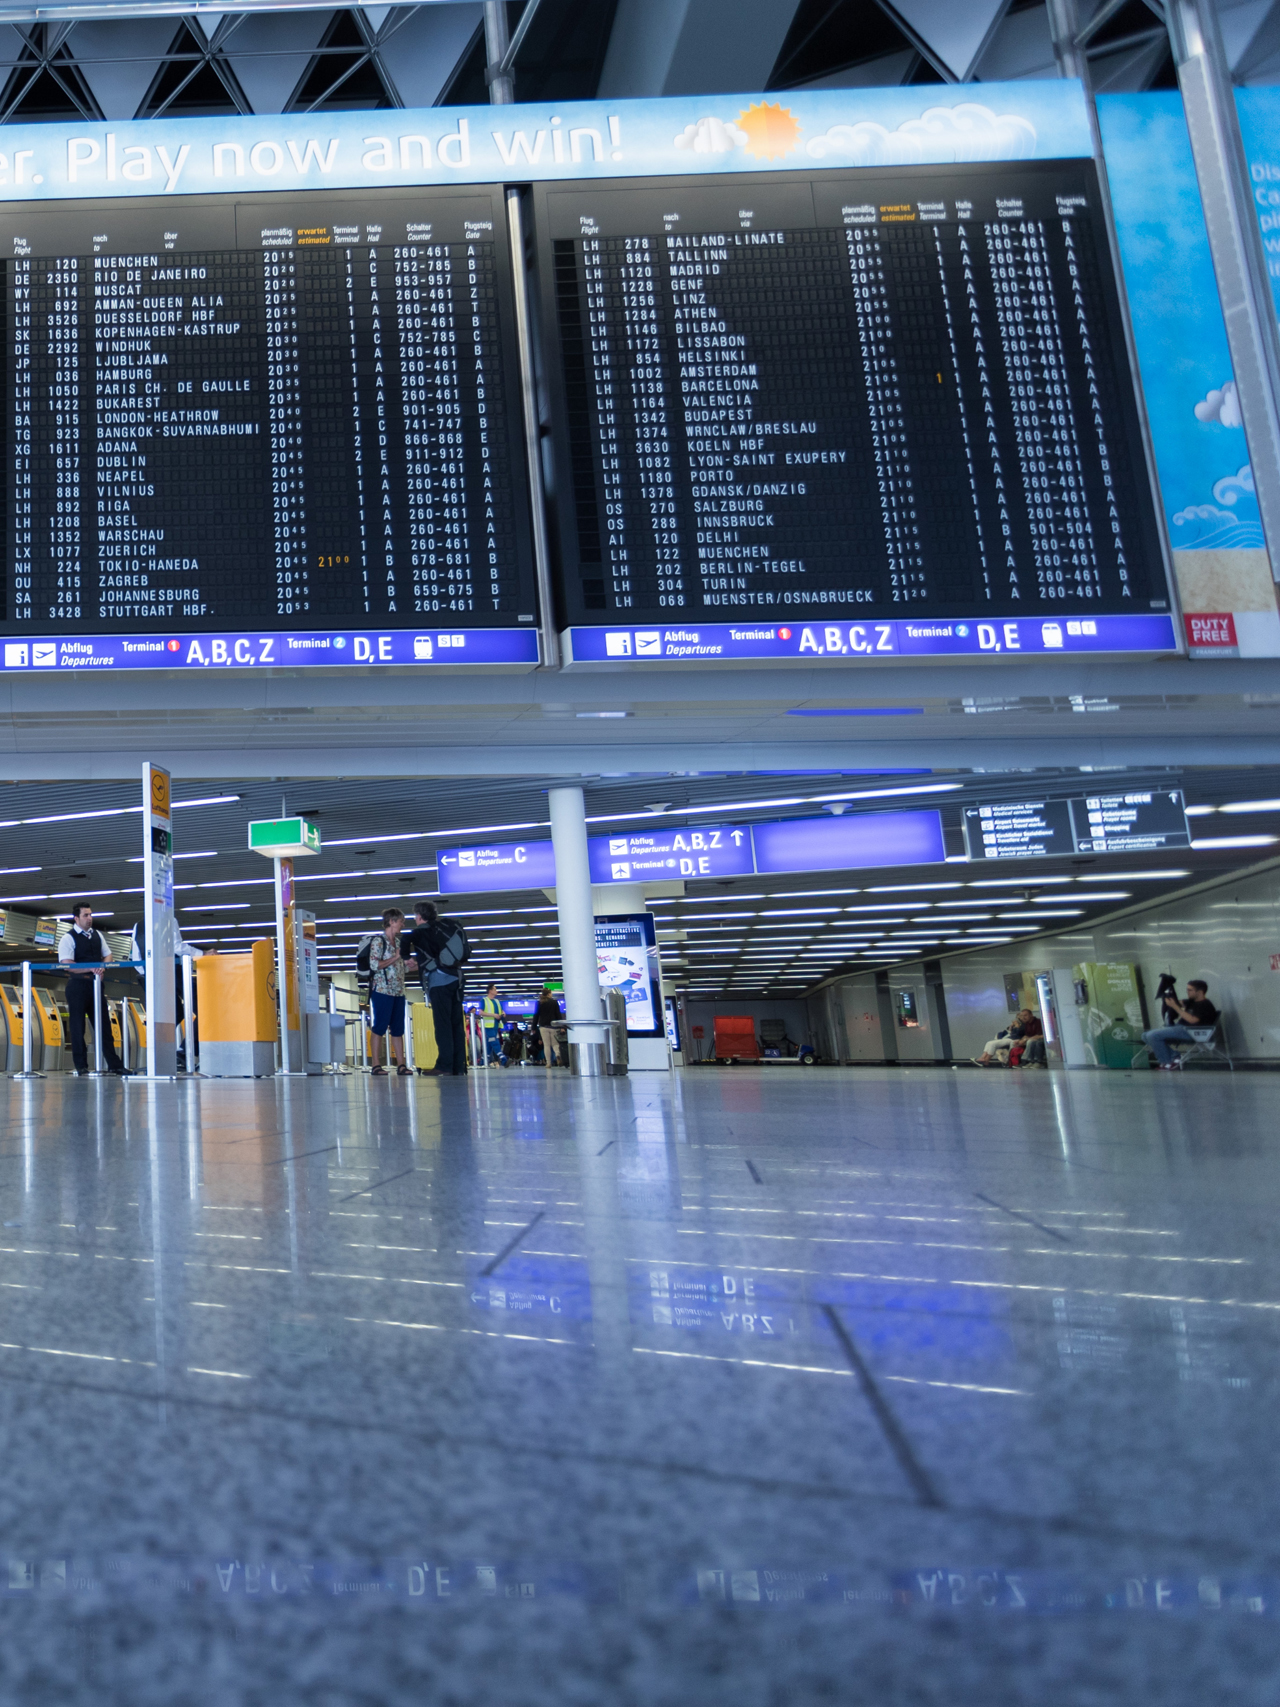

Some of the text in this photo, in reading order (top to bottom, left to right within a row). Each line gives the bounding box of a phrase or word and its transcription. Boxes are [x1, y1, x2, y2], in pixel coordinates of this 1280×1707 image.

[66, 136, 190, 190] Play
[211, 133, 342, 177] now
[360, 119, 466, 171] and
[492, 117, 622, 166] win!
[582, 221, 1043, 251] LH 278 MAILAND-LINATE 260-461
[14, 316, 453, 341] SK 1636 KOPENHAGEN-KASTRUP 260-461
[680, 378, 759, 392] BARCELONA
[14, 417, 461, 441] TG 923 BANGKOK-SUVARNABHUMI 741-747
[685, 422, 816, 437] WRNCLAW/BRESLAU
[691, 482, 806, 497] GDANSK/DANZIG
[97, 529, 164, 541] WARSCHAU
[98, 558, 198, 572] TOKIO-HANEDA
[98, 588, 199, 602] JOHANNESBURG
[614, 584, 1101, 608] LH 068 MUENSTER/OSNABRUECK 260-461
[1191, 618, 1228, 630] DUTY
[665, 631, 699, 643] Abflug
[729, 630, 774, 640] Terminal
[906, 626, 952, 637] Terminal
[1194, 630, 1229, 642] FREE
[60, 643, 92, 654] Abflug
[122, 641, 164, 651] Terminal
[287, 638, 329, 648] Terminal
[666, 645, 722, 656] Departures
[61, 656, 114, 667] Departures
[630, 838, 654, 846] Abflug
[477, 850, 498, 858] Abflug
[515, 847, 526, 863] C
[631, 846, 669, 855] Departures
[477, 858, 512, 866] Departures
[632, 860, 663, 869] Terminal
